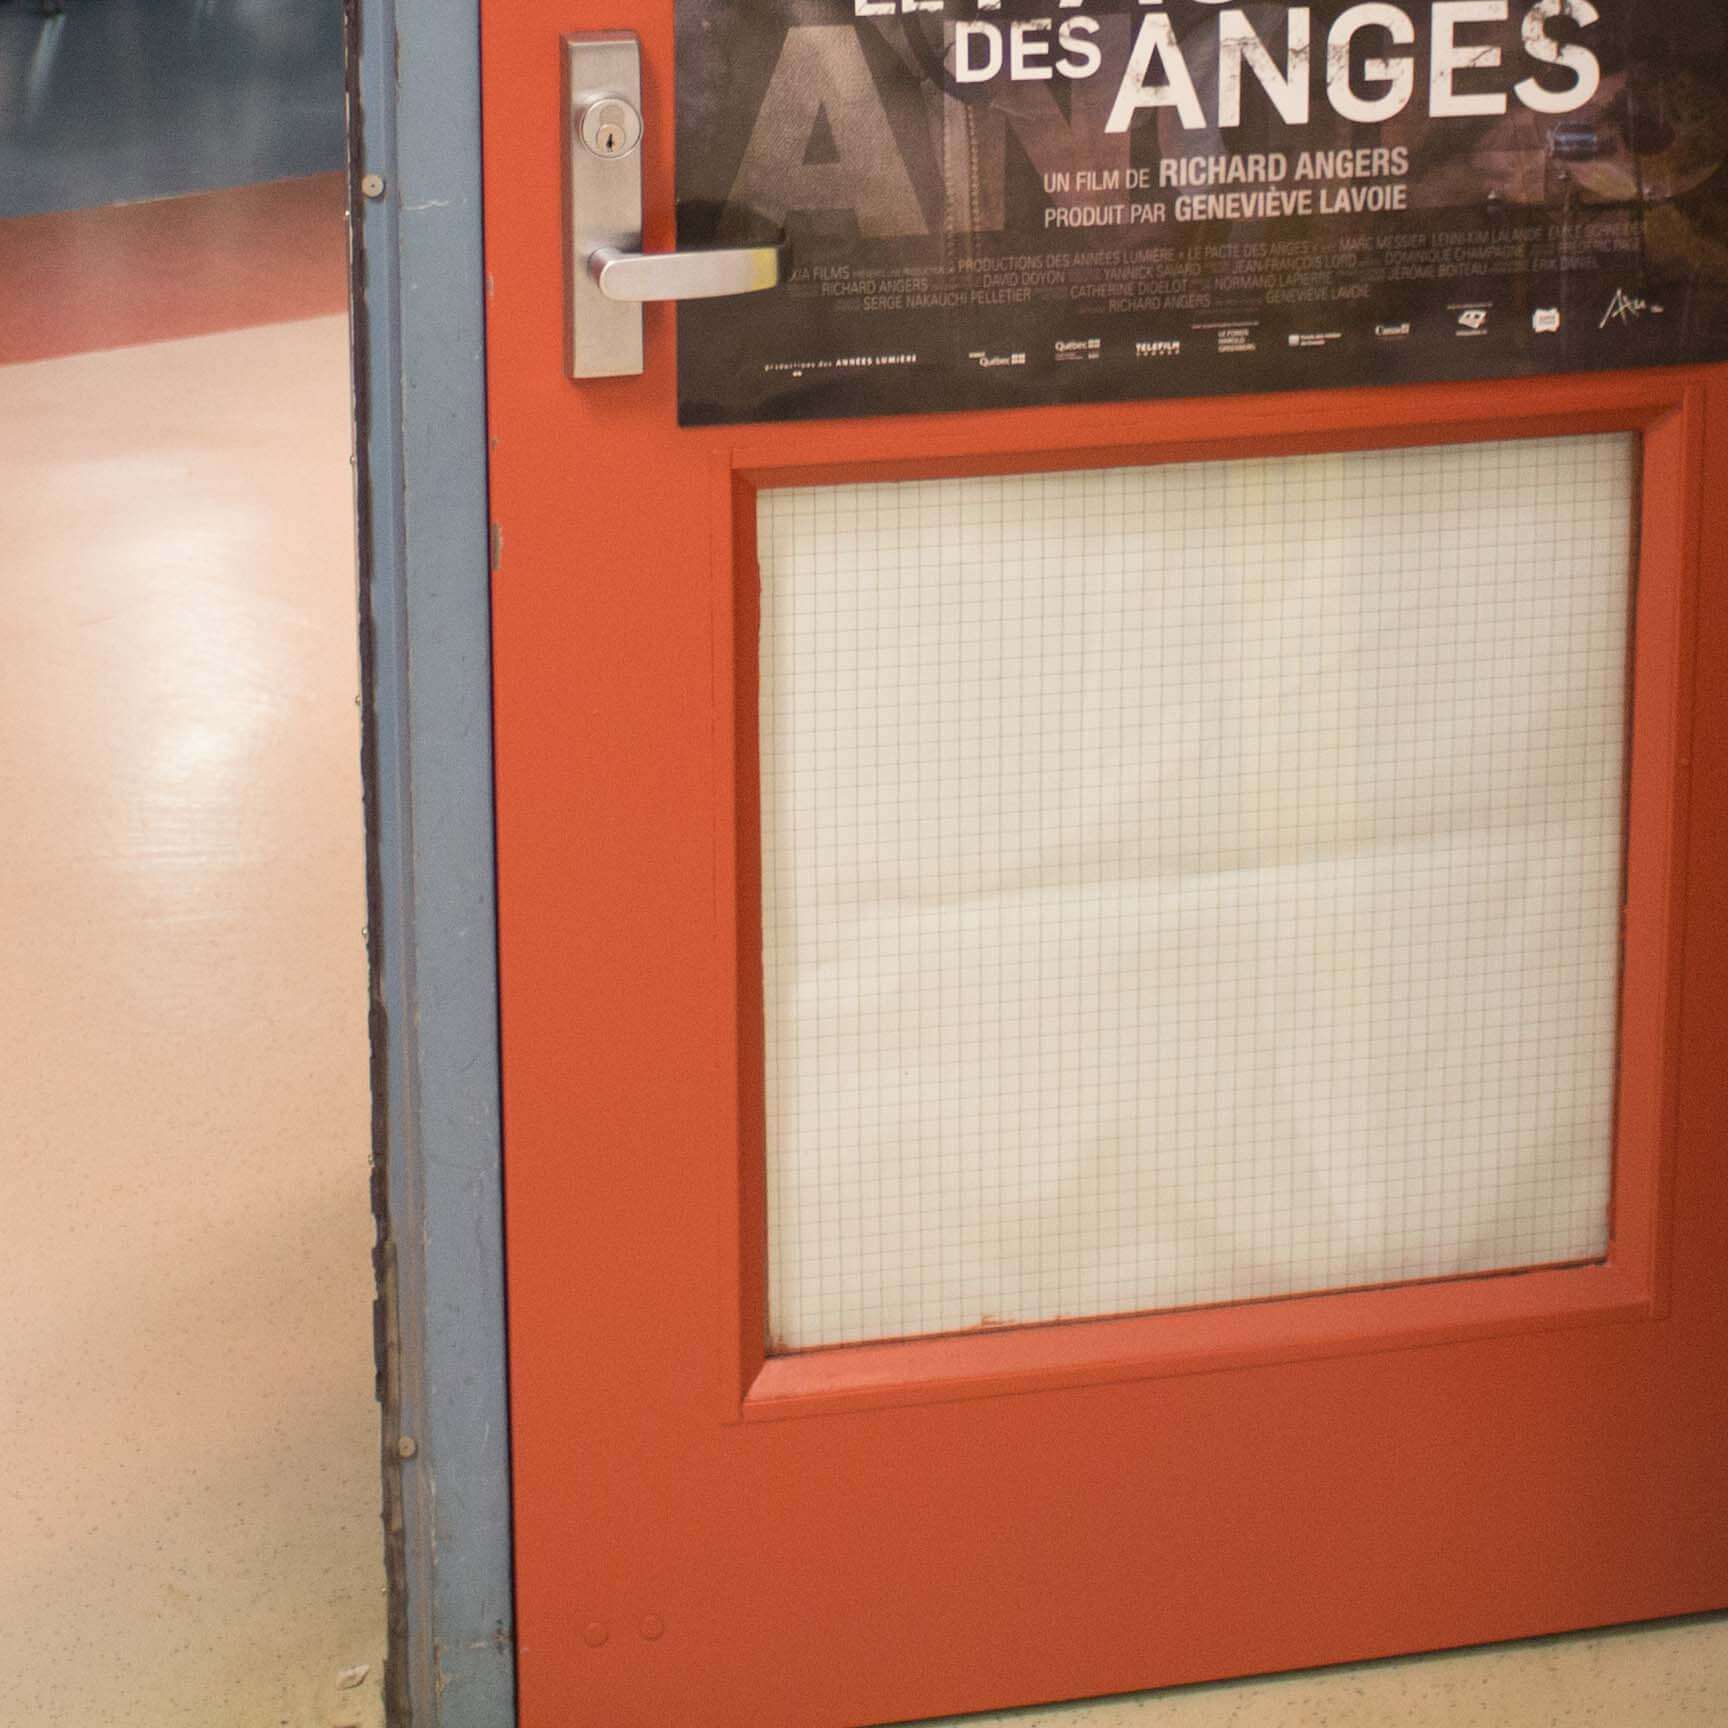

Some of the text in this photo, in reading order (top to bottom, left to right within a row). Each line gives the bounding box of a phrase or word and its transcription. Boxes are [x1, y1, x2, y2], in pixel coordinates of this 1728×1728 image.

[955, 17, 1101, 84] DES
[1043, 146, 1409, 193] UN FILM DE RICHARD ANGERS
[1044, 184, 1407, 229] PRODUIT PAR GENEVIÈVE LAVOIE
[813, 265, 850, 280] FILMS
[958, 255, 1043, 273] PRODUCTIONS
[1046, 253, 1070, 269] DES
[1073, 249, 1121, 267] ANNÉES
[1189, 246, 1202, 262] LE
[1205, 242, 1240, 260] PACTE
[1242, 241, 1267, 258] DES
[821, 280, 876, 296] RICHARD
[879, 277, 928, 293] ANGERS
[983, 272, 1018, 289] DAVID
[1021, 269, 1065, 286] DOYON
[863, 294, 902, 311] SERGE
[970, 286, 1031, 305] PELLETIER
[1108, 295, 1161, 313] RICHARD
[1163, 292, 1211, 310] ANGERS
